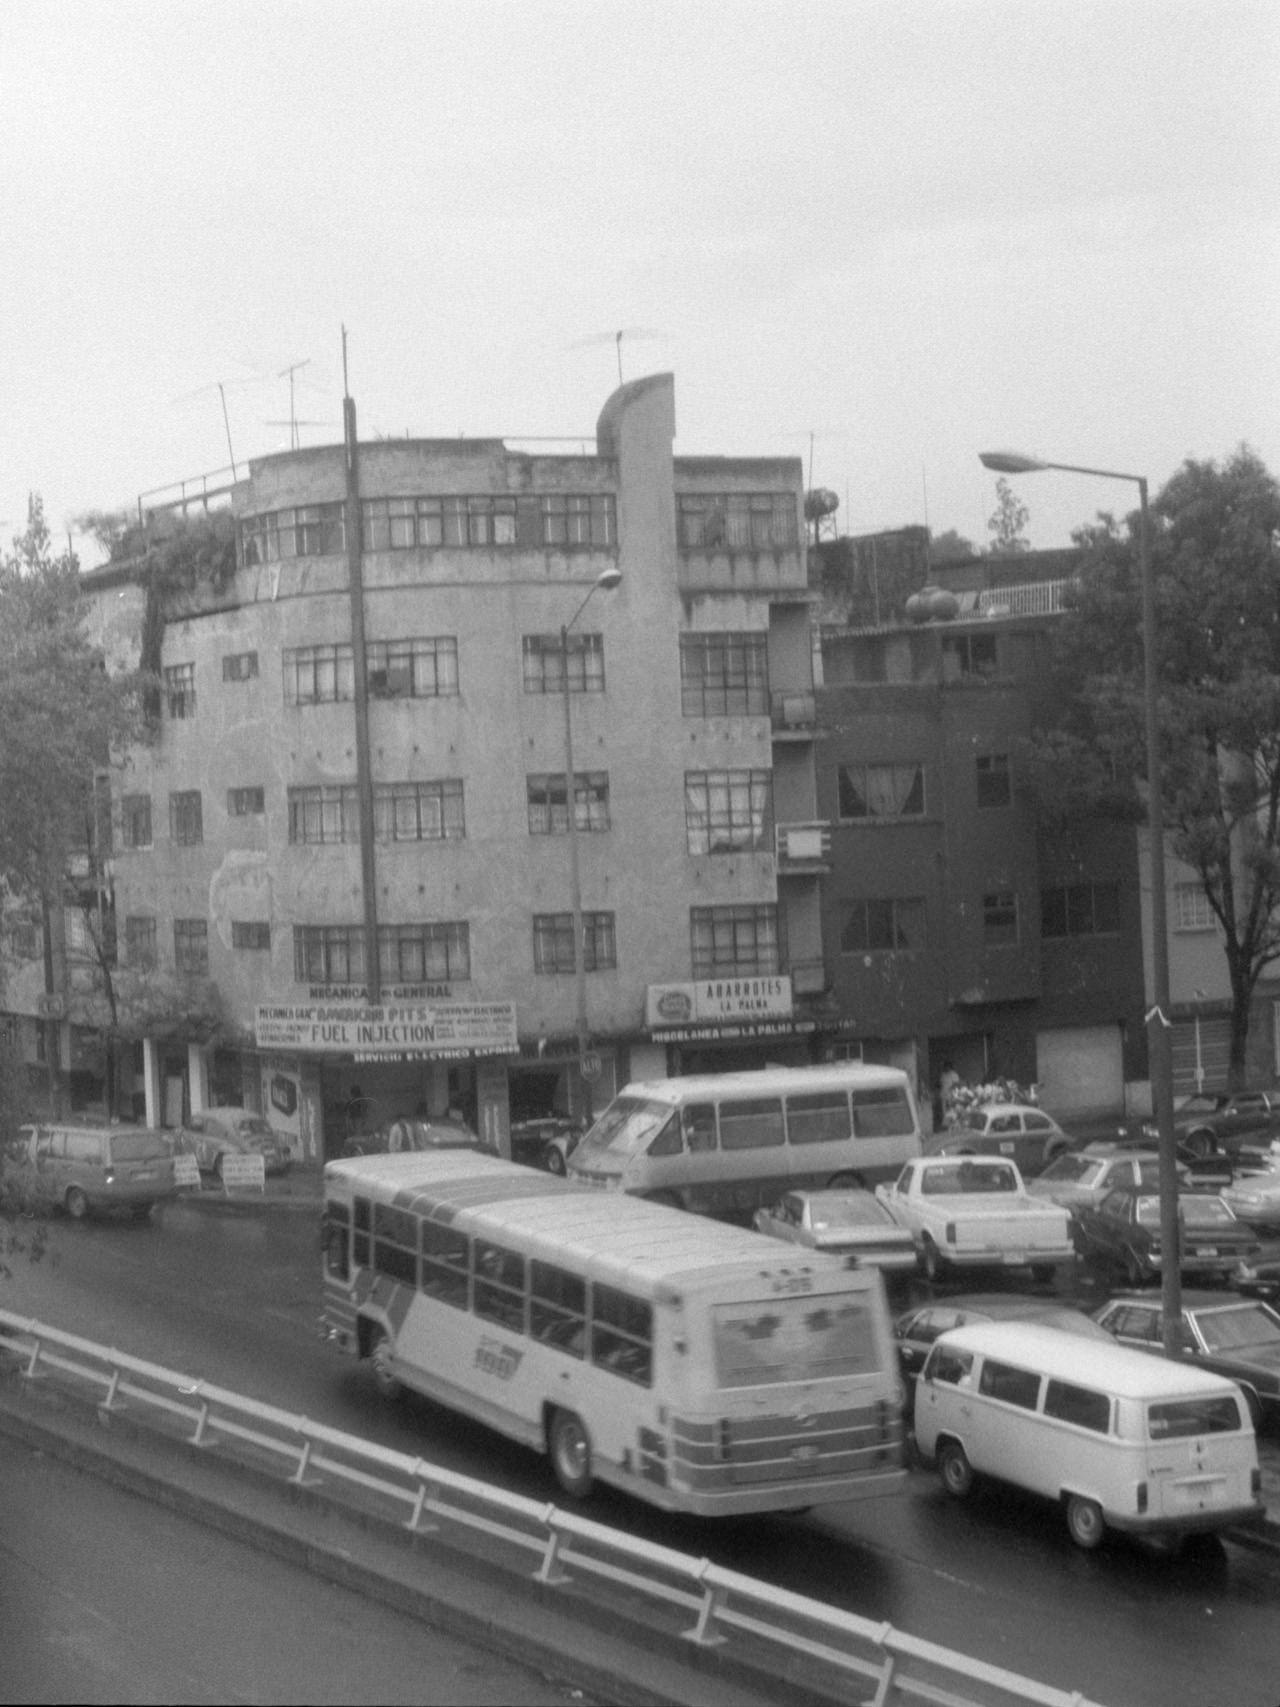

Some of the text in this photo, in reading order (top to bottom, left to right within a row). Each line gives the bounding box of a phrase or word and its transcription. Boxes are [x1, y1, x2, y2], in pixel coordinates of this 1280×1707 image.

[309, 986, 369, 999] MECANICA
[393, 985, 452, 998] GENERAL
[706, 980, 782, 998] ABARROTES
[720, 999, 768, 1011] LA PALMA
[312, 1024, 349, 1042] FUEL
[357, 1024, 435, 1042] INJECTION
[742, 1025, 755, 1037] LA
